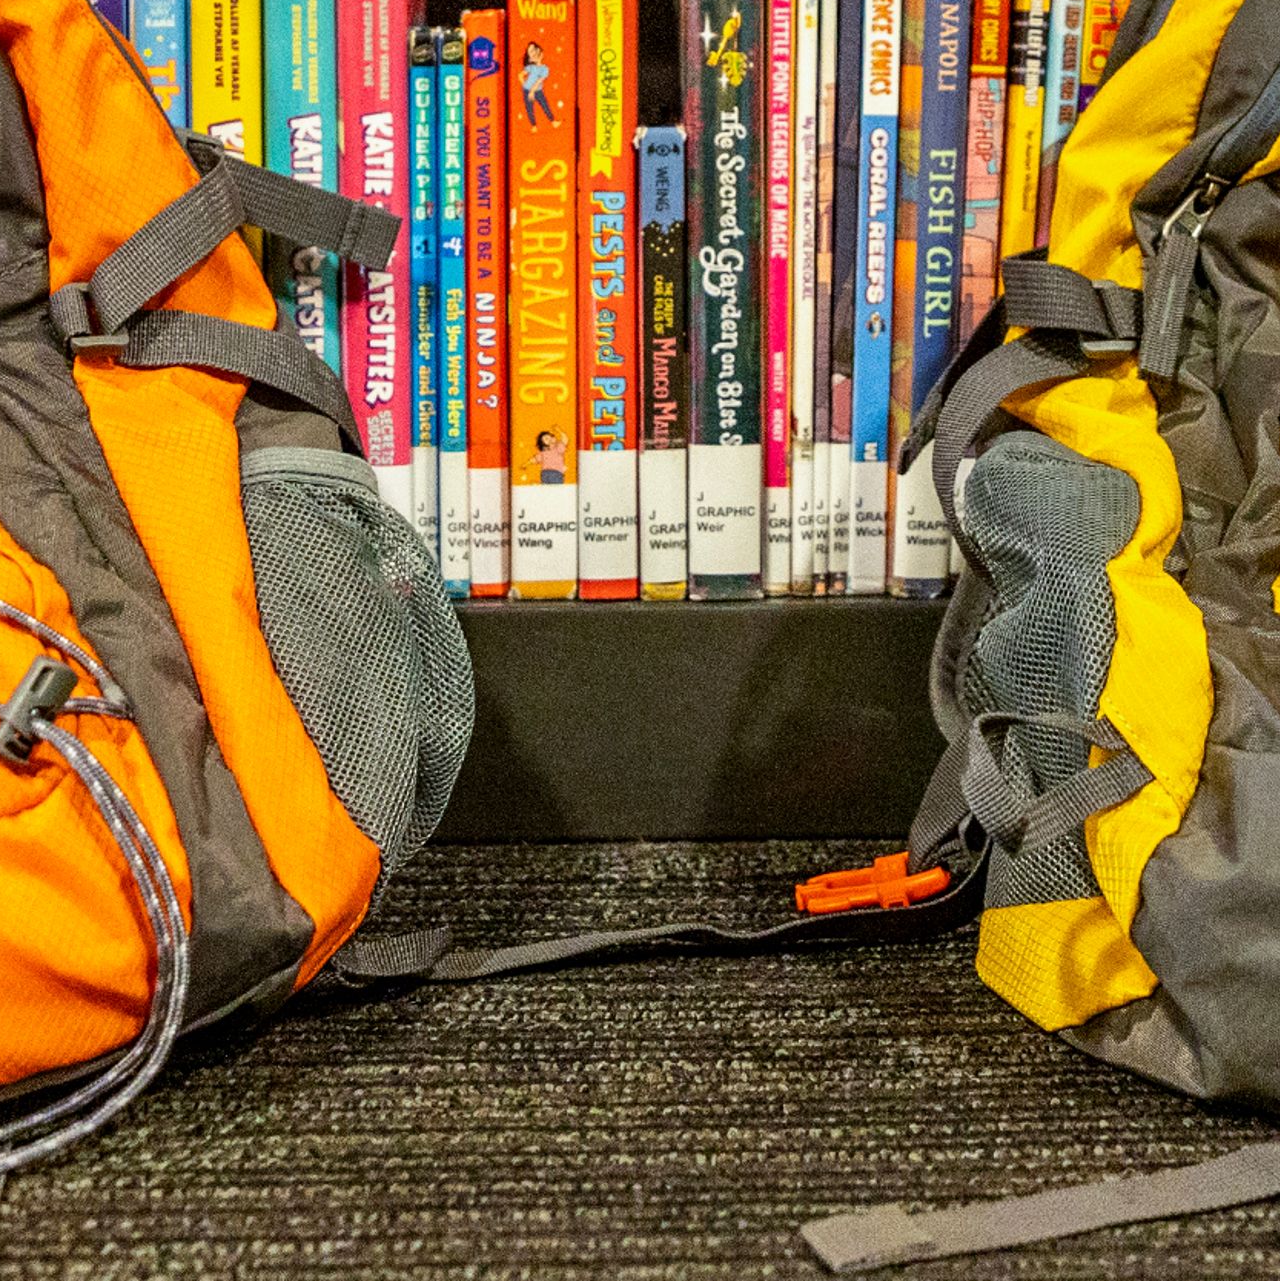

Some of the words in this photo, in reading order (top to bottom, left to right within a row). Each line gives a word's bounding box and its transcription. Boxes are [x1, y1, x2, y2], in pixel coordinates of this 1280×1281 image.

[774, 11, 789, 57] LITTLE
[940, 3, 960, 91] NAPOLI
[772, 61, 788, 109] PONY:
[870, 41, 891, 96] COMICS
[475, 97, 491, 119] SO
[717, 106, 746, 148] The
[361, 113, 392, 195] KATIE
[475, 125, 491, 157] YOU
[772, 114, 788, 181] LEGENDS
[475, 164, 491, 209] WANT
[772, 185, 788, 204] OF
[869, 128, 889, 218] CORAL
[928, 148, 955, 235] FISH
[717, 153, 746, 242] Secret
[475, 216, 491, 236] TO
[591, 190, 626, 299] PESTS
[772, 209, 787, 257] MAGIC
[476, 242, 491, 262] BE
[867, 221, 887, 304] REEFS
[447, 289, 463, 321] Fish
[519, 160, 567, 404] STARGAZING
[702, 248, 746, 349] Garden
[924, 246, 953, 337] GIRL
[447, 325, 463, 350] You
[475, 292, 498, 410] NINJA?
[598, 308, 621, 363] and
[447, 354, 463, 395] Were
[721, 354, 735, 378] on
[447, 400, 464, 437] Here
[720, 381, 740, 428] 81st
